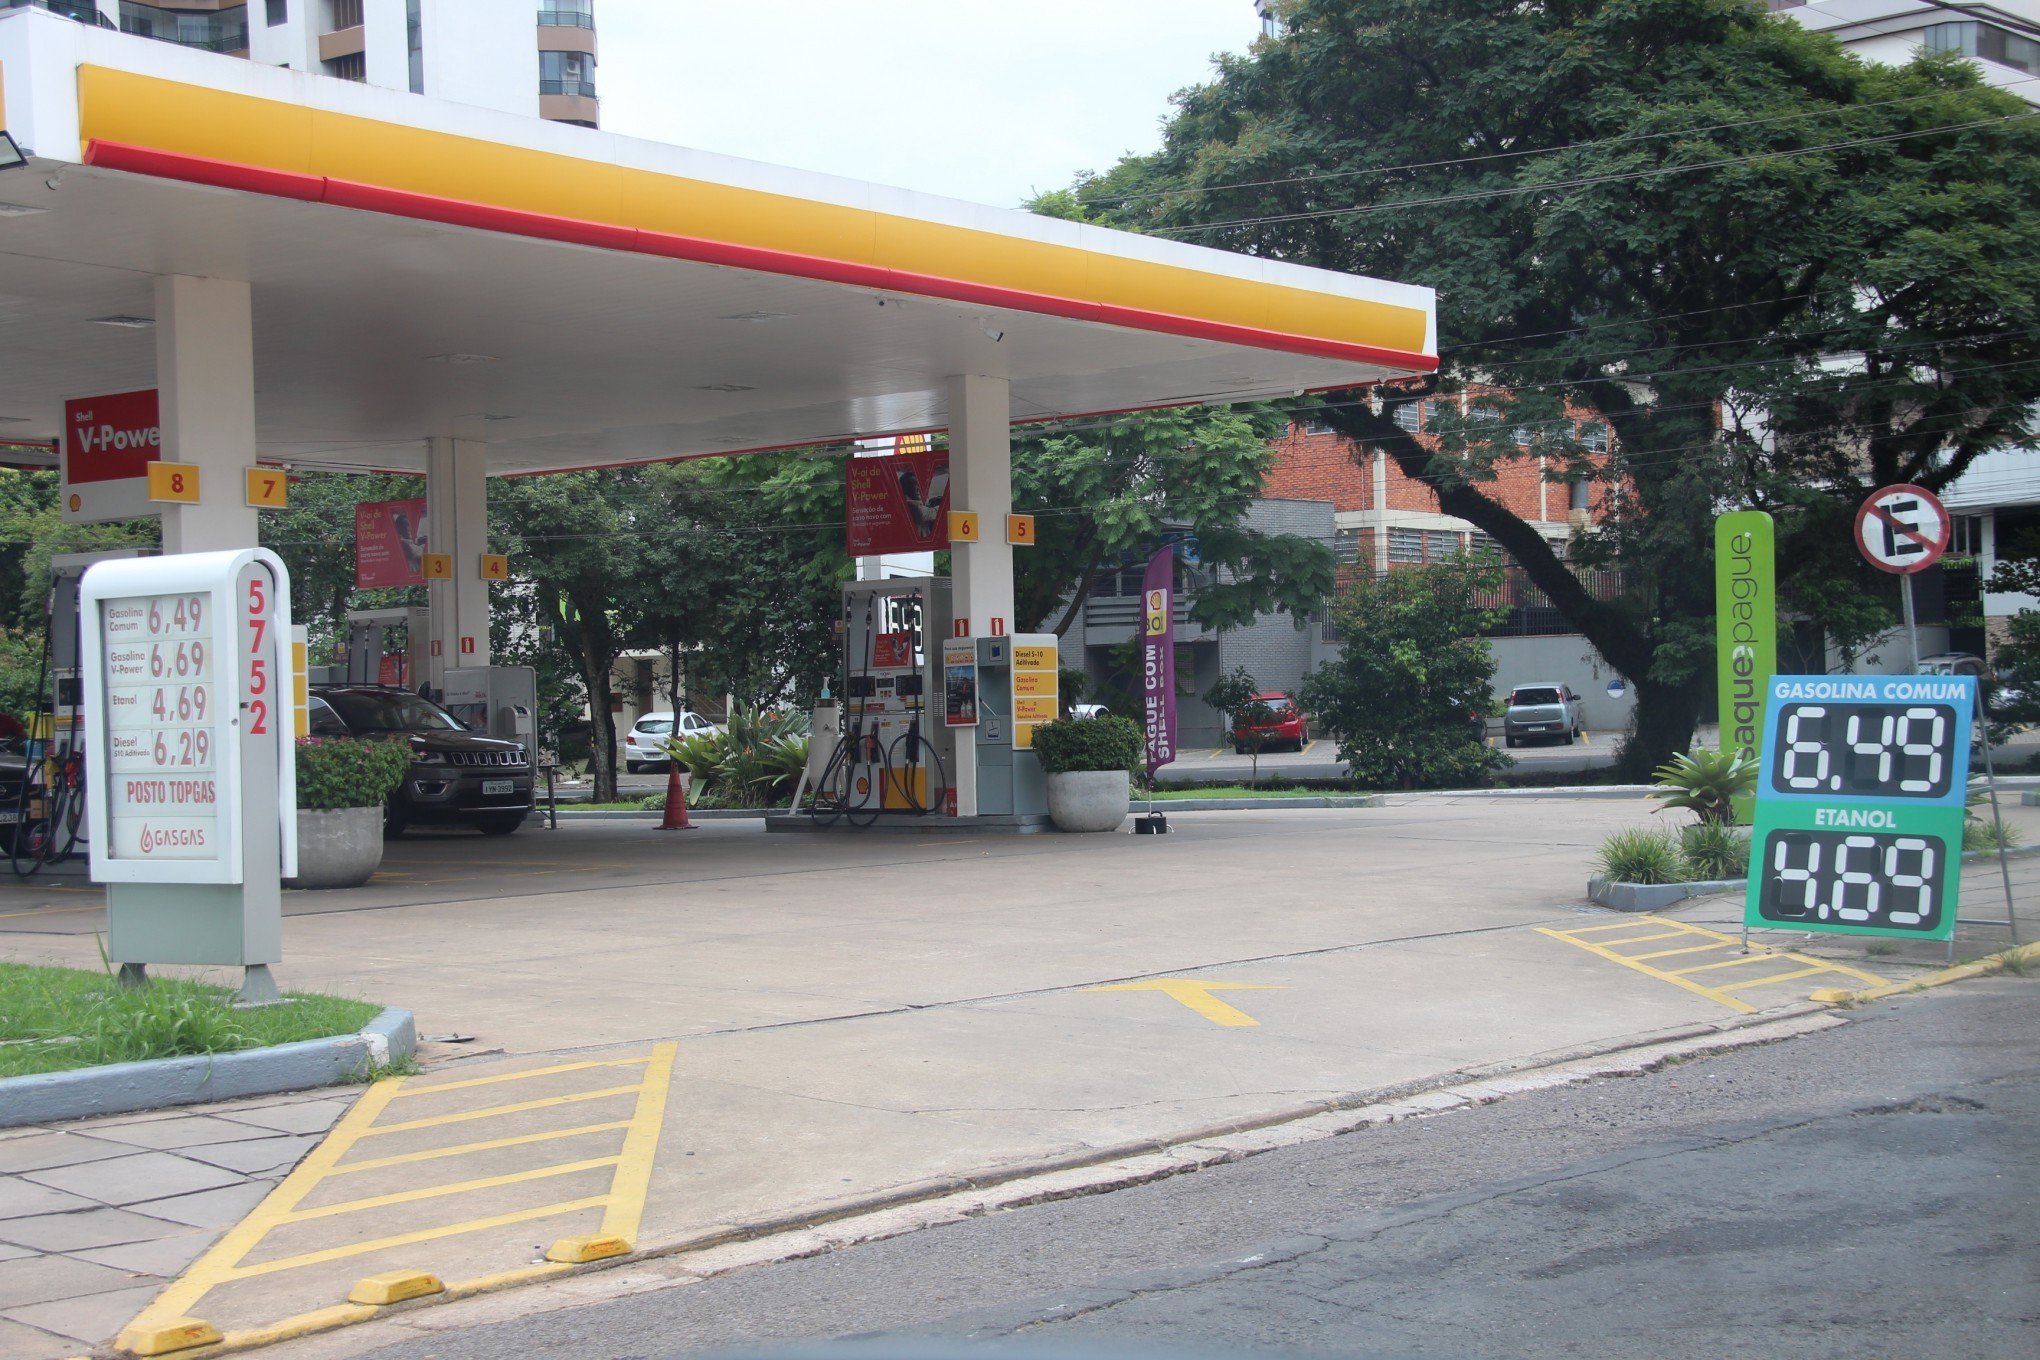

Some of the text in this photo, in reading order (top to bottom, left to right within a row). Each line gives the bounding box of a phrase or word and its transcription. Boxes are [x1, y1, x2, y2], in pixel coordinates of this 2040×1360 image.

[75, 411, 93, 422] Shell
[77, 425, 161, 453] V-Powe
[171, 473, 185, 494] 8
[263, 479, 276, 498] 7
[961, 520, 970, 535] 6
[1017, 522, 1026, 537] 5
[434, 560, 443, 574] 3
[490, 561, 499, 574] 4
[109, 607, 144, 619] Gasolina
[149, 597, 202, 634] 6,49
[109, 621, 139, 632] Comum
[110, 651, 146, 662] Gasolina
[151, 641, 204, 678] 6,69
[110, 665, 144, 675] V-Power
[1146, 644, 1157, 690] COM
[113, 694, 137, 705] Etanol
[1774, 682, 1966, 700] GASOLINA COMUM
[152, 685, 207, 721] 4,69
[114, 736, 138, 747] Diesel
[154, 729, 209, 766] 6,29
[1782, 706, 1945, 792] 6.49
[125, 749, 151, 757] Aditivado
[127, 780, 216, 804] POSTO TOPGAS
[1815, 808, 1896, 828] ETANOL
[1774, 835, 1934, 925] 4.69
